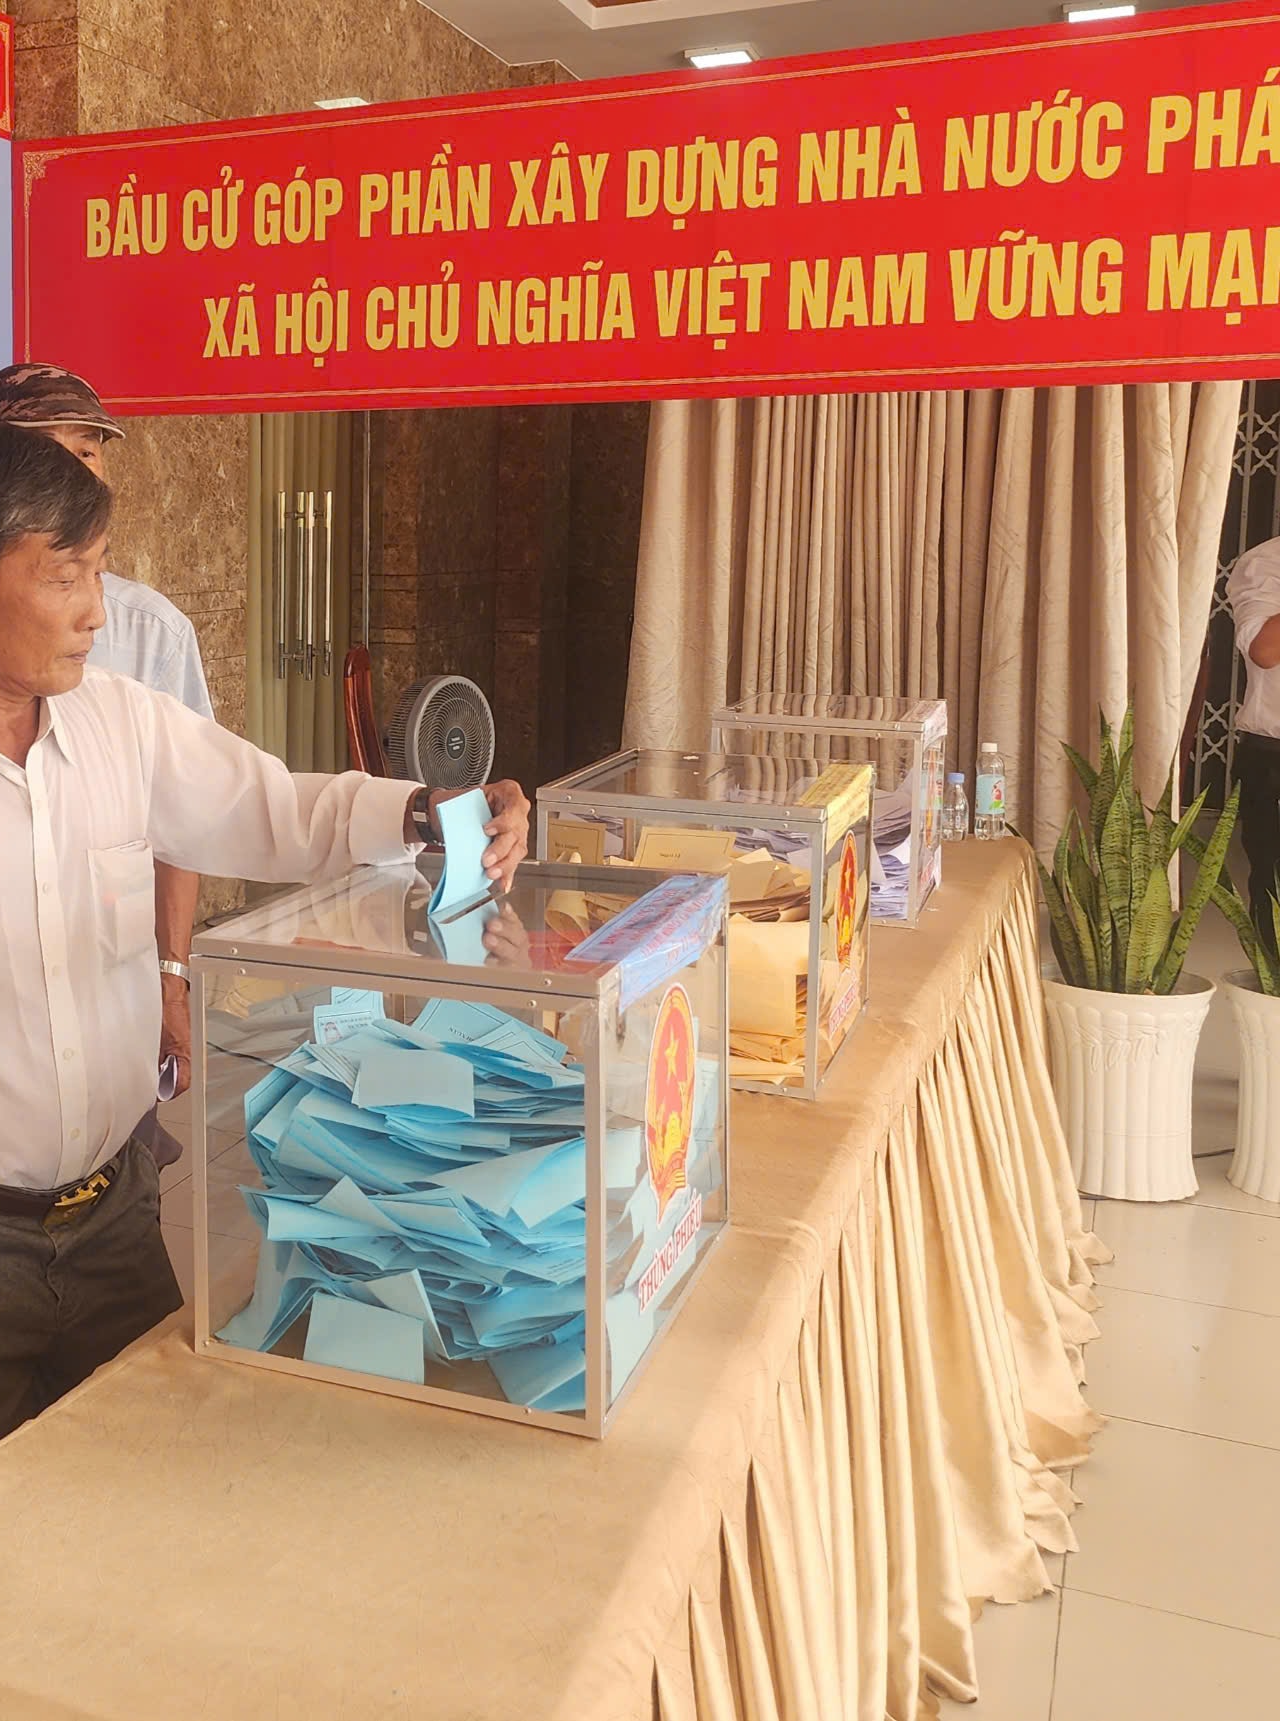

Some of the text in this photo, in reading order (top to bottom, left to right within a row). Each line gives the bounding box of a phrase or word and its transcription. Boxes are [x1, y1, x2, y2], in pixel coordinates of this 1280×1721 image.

[87, 174, 167, 257] BẦU
[183, 166, 243, 251] CỬ
[254, 167, 342, 246] GÓP
[360, 144, 490, 237] PHẦN
[507, 142, 609, 226] XÂY
[627, 136, 778, 230] DỰNG
[798, 107, 921, 203] NHÀ
[944, 90, 1123, 191] NƯỚC
[203, 284, 260, 357] XÃ
[276, 278, 348, 367] HỘI
[366, 261, 459, 350] CHỦ
[478, 260, 635, 345] NGHĨA
[655, 250, 770, 349] VIỆT
[789, 252, 927, 330] NAM
[950, 230, 1123, 321] VỮNG
[640, 1242, 674, 1310] THÙNG
